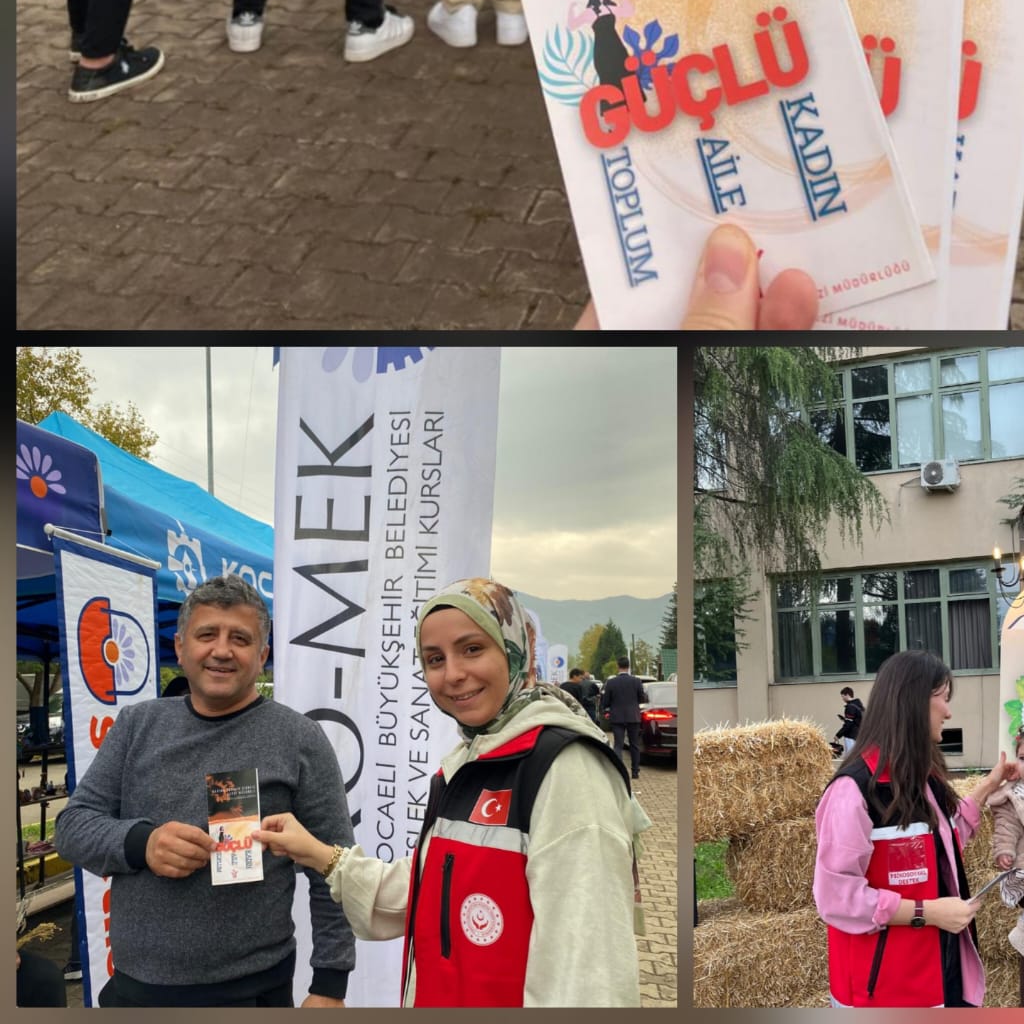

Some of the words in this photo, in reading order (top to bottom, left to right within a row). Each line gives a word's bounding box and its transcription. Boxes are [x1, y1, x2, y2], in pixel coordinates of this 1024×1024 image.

[578, 6, 810, 150] GÜÇLÜ
[602, 146, 658, 287] TOPLUM
[699, 137, 747, 213] AİLE
[780, 92, 848, 221] KADIN
[832, 260, 911, 295] MÜDÜRLÜĞÜ
[385, 411, 412, 559] BELEDİYESİ
[418, 411, 445, 534] KURSLARI
[376, 575, 405, 746] BÜYÜKŞEHİR
[409, 750, 429, 782] VE
